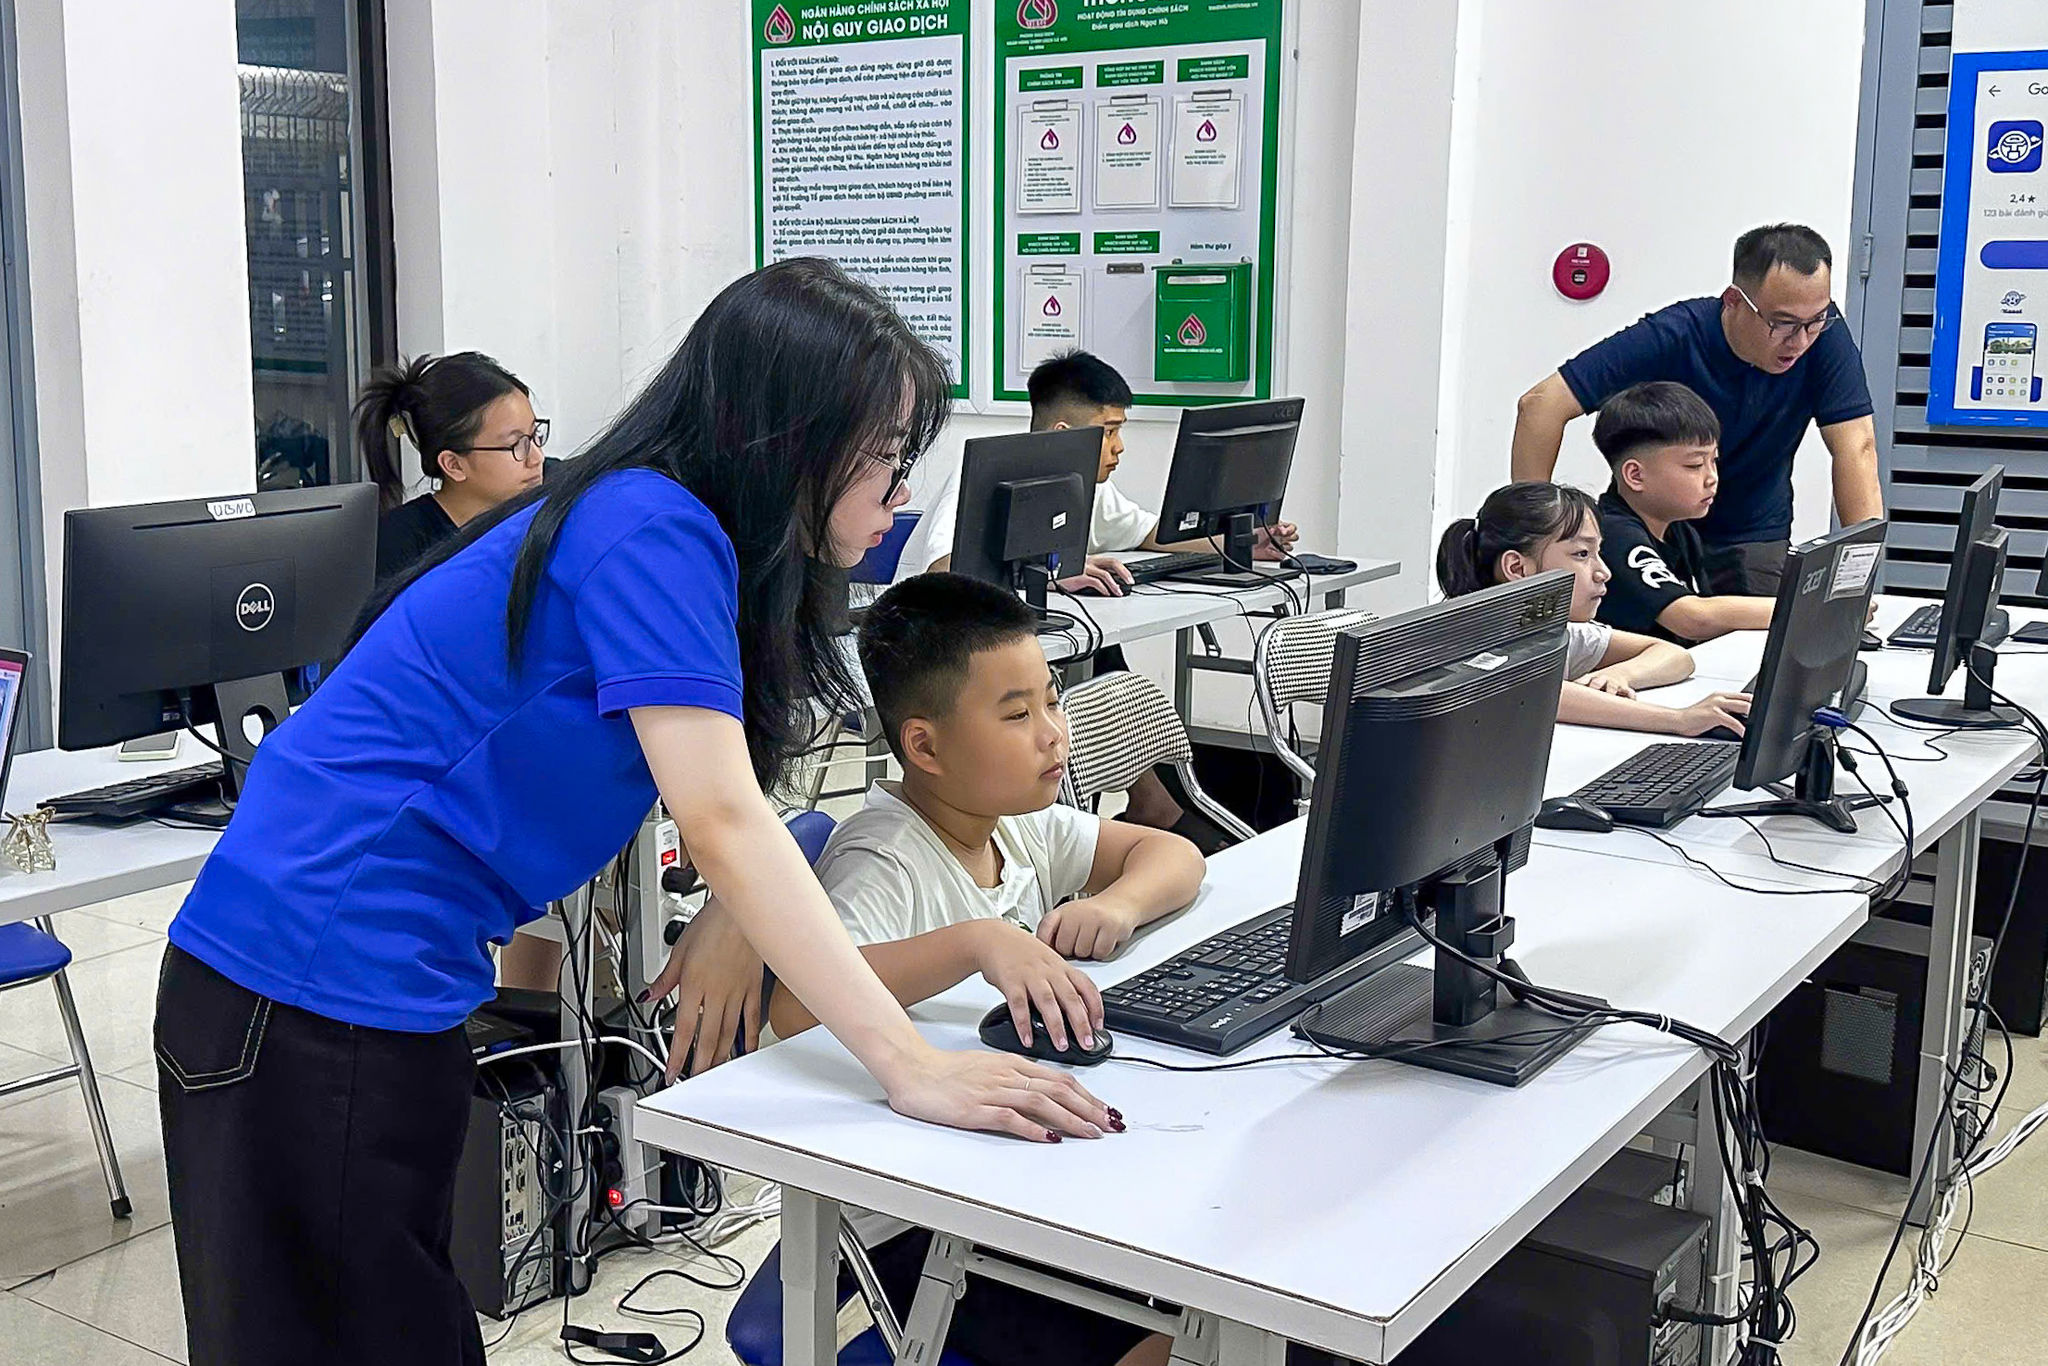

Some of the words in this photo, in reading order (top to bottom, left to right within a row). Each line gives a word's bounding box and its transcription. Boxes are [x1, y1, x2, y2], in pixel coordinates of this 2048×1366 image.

[802, 6, 827, 19] NGÂN
[829, 4, 856, 17] HÀNG
[857, 0, 886, 14] CHÍNH
[888, 0, 914, 12] SÁCH
[802, 20, 828, 43] NỘI
[832, 20, 863, 37] QUY
[866, 16, 906, 35] GIAO
[910, 14, 948, 34] DỊCH
[2010, 194, 2025, 204] 2,4
[1984, 209, 1996, 218] 123
[2014, 208, 2036, 217] đánh
[240, 600, 270, 616] DELL
